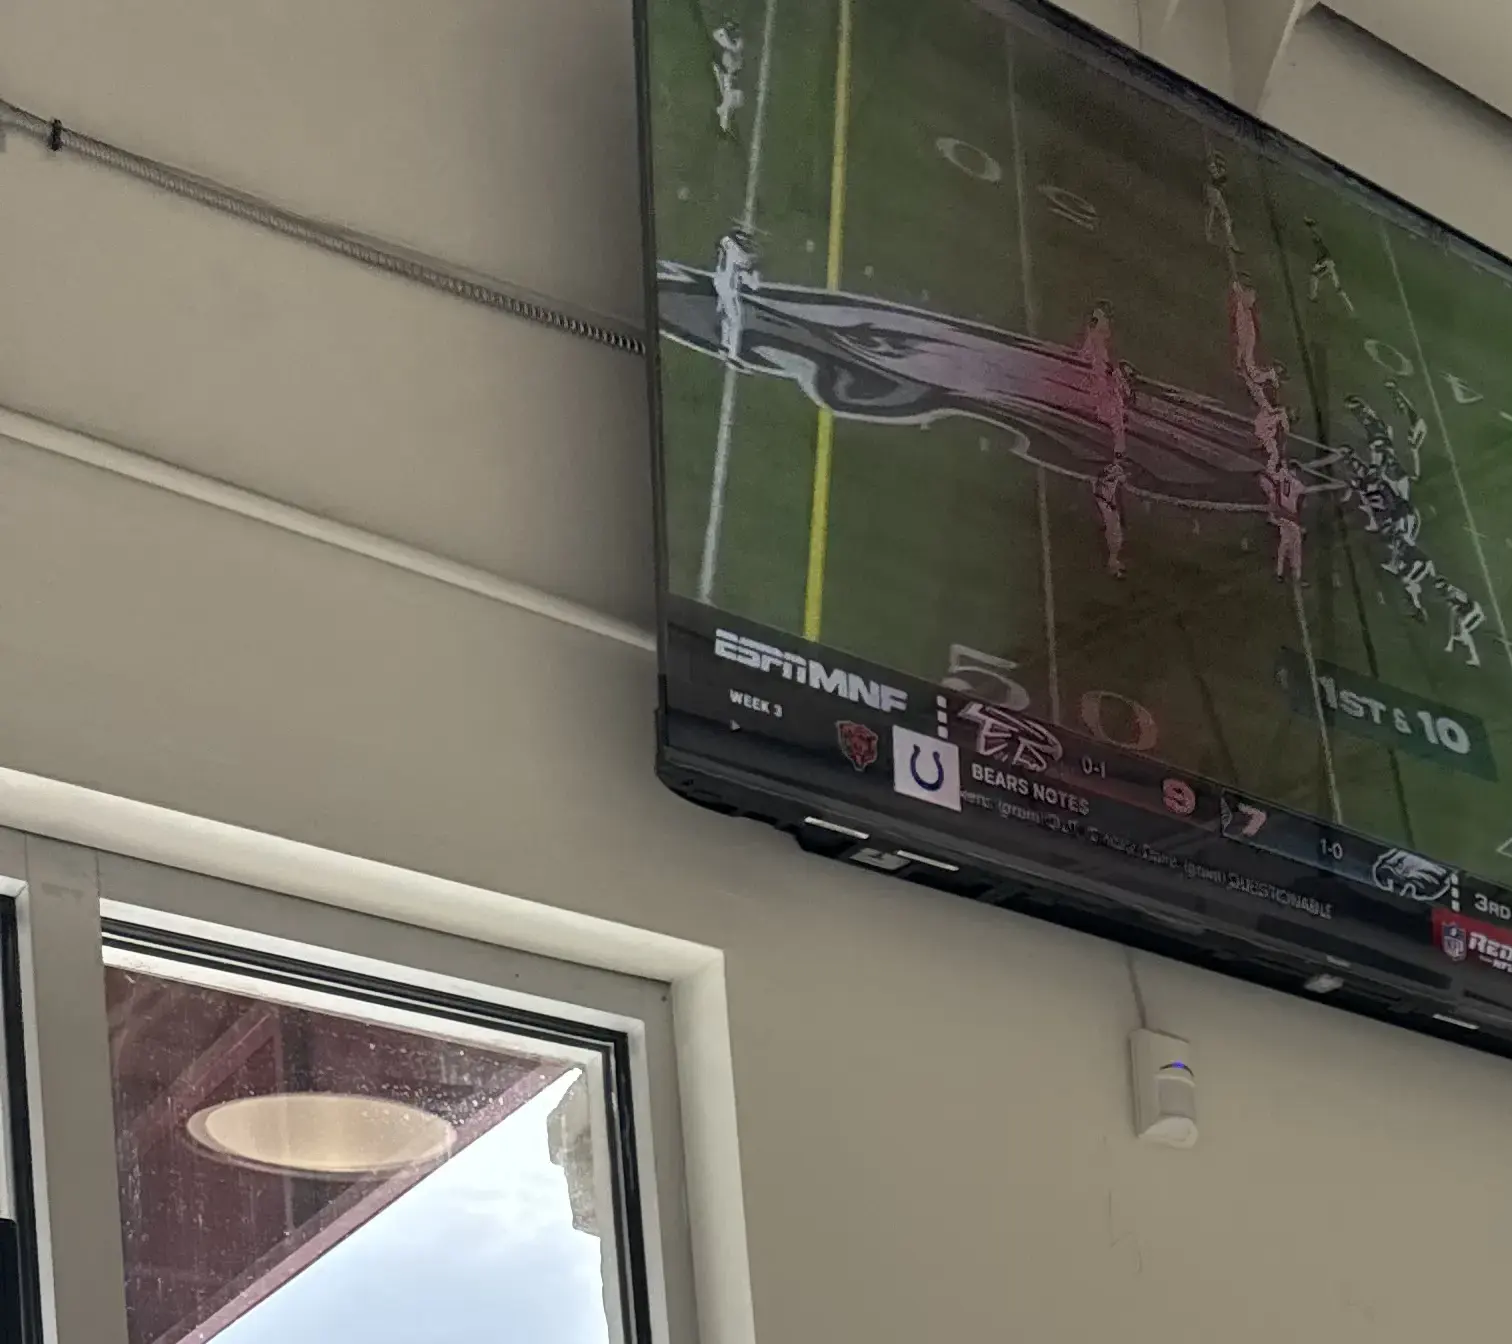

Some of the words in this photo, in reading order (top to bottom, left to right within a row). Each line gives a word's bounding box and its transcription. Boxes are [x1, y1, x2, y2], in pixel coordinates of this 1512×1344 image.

[728, 688, 770, 715] WEEK
[1417, 710, 1471, 755] 10
[970, 762, 1030, 798] BEARS
[1033, 779, 1091, 817] NOTES
[1319, 838, 1344, 860] 1-0
[1474, 893, 1512, 921] 3RD
